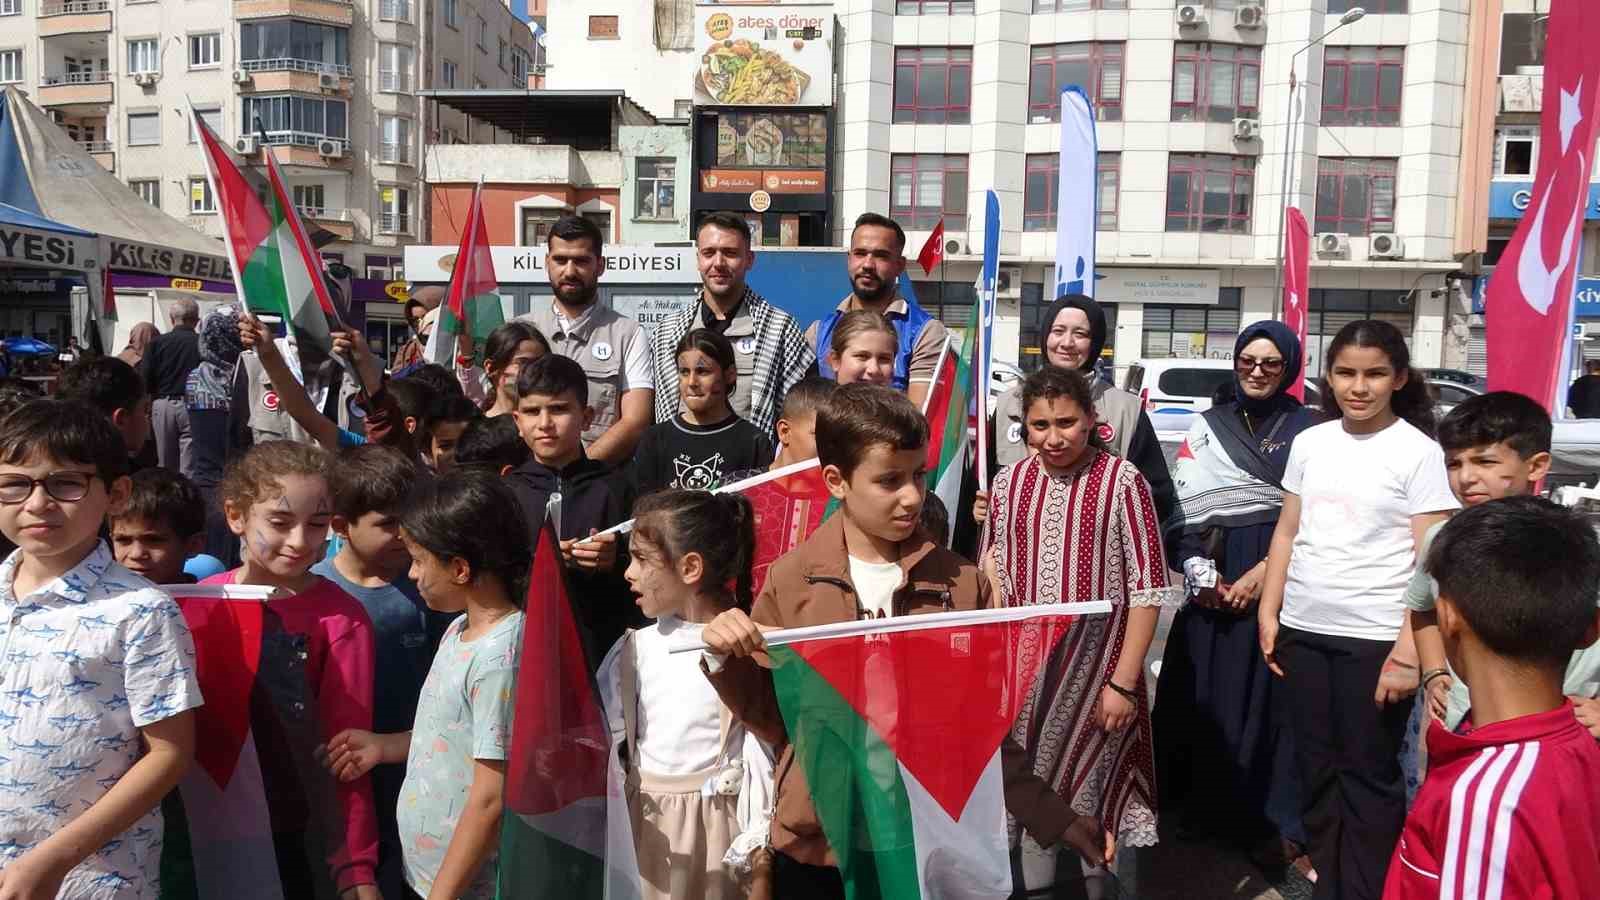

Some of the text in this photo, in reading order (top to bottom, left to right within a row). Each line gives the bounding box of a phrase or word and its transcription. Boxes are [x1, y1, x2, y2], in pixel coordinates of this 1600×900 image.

[180, 253, 233, 279] BELE
[513, 252, 681, 271] KİL EDİYESİ
